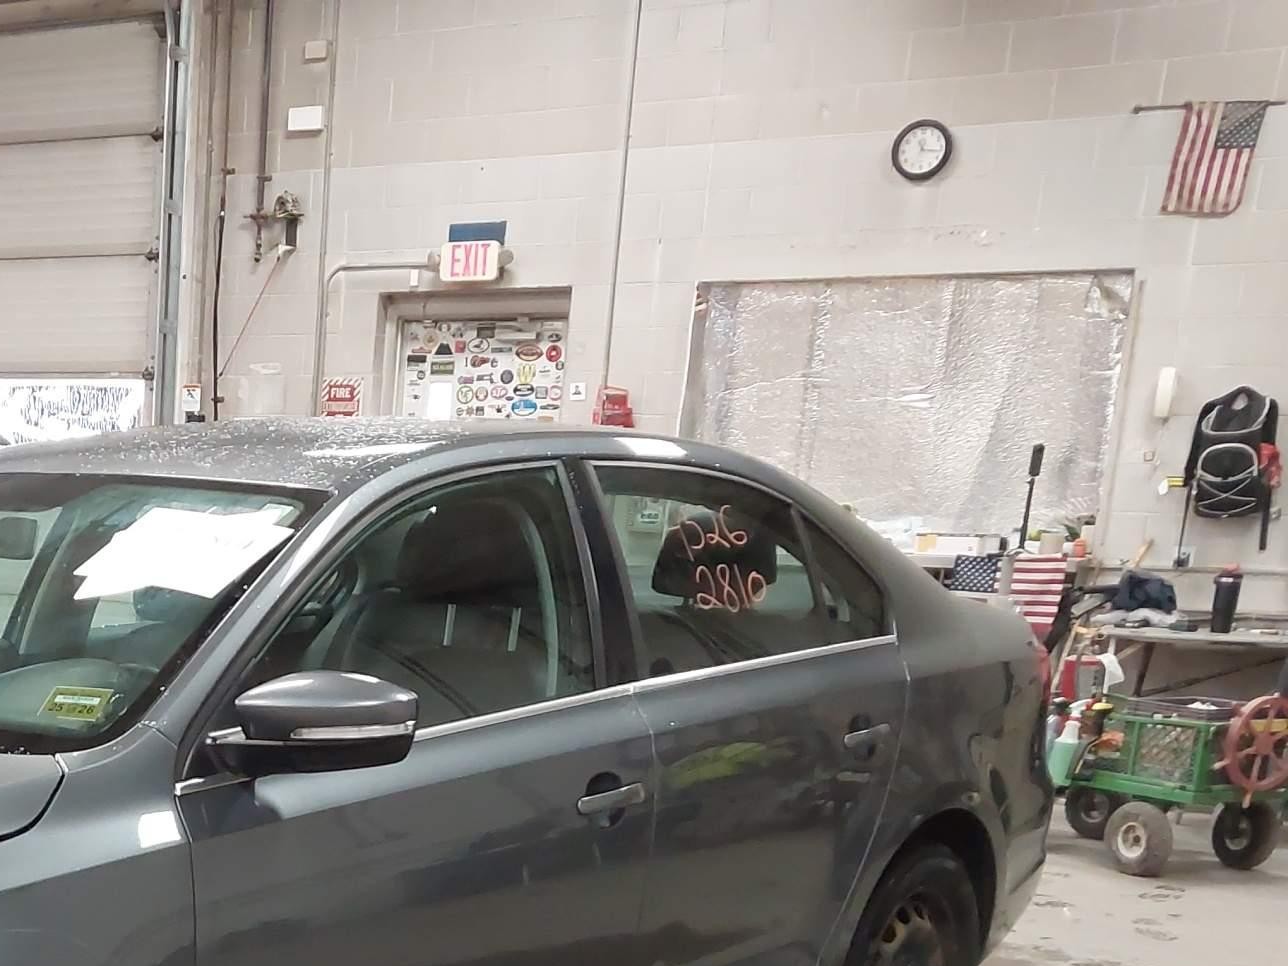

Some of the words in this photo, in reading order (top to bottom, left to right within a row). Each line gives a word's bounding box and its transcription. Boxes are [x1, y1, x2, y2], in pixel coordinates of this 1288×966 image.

[450, 243, 491, 277] EXIT
[330, 387, 352, 399] FIRE
[695, 563, 767, 613] 2810
